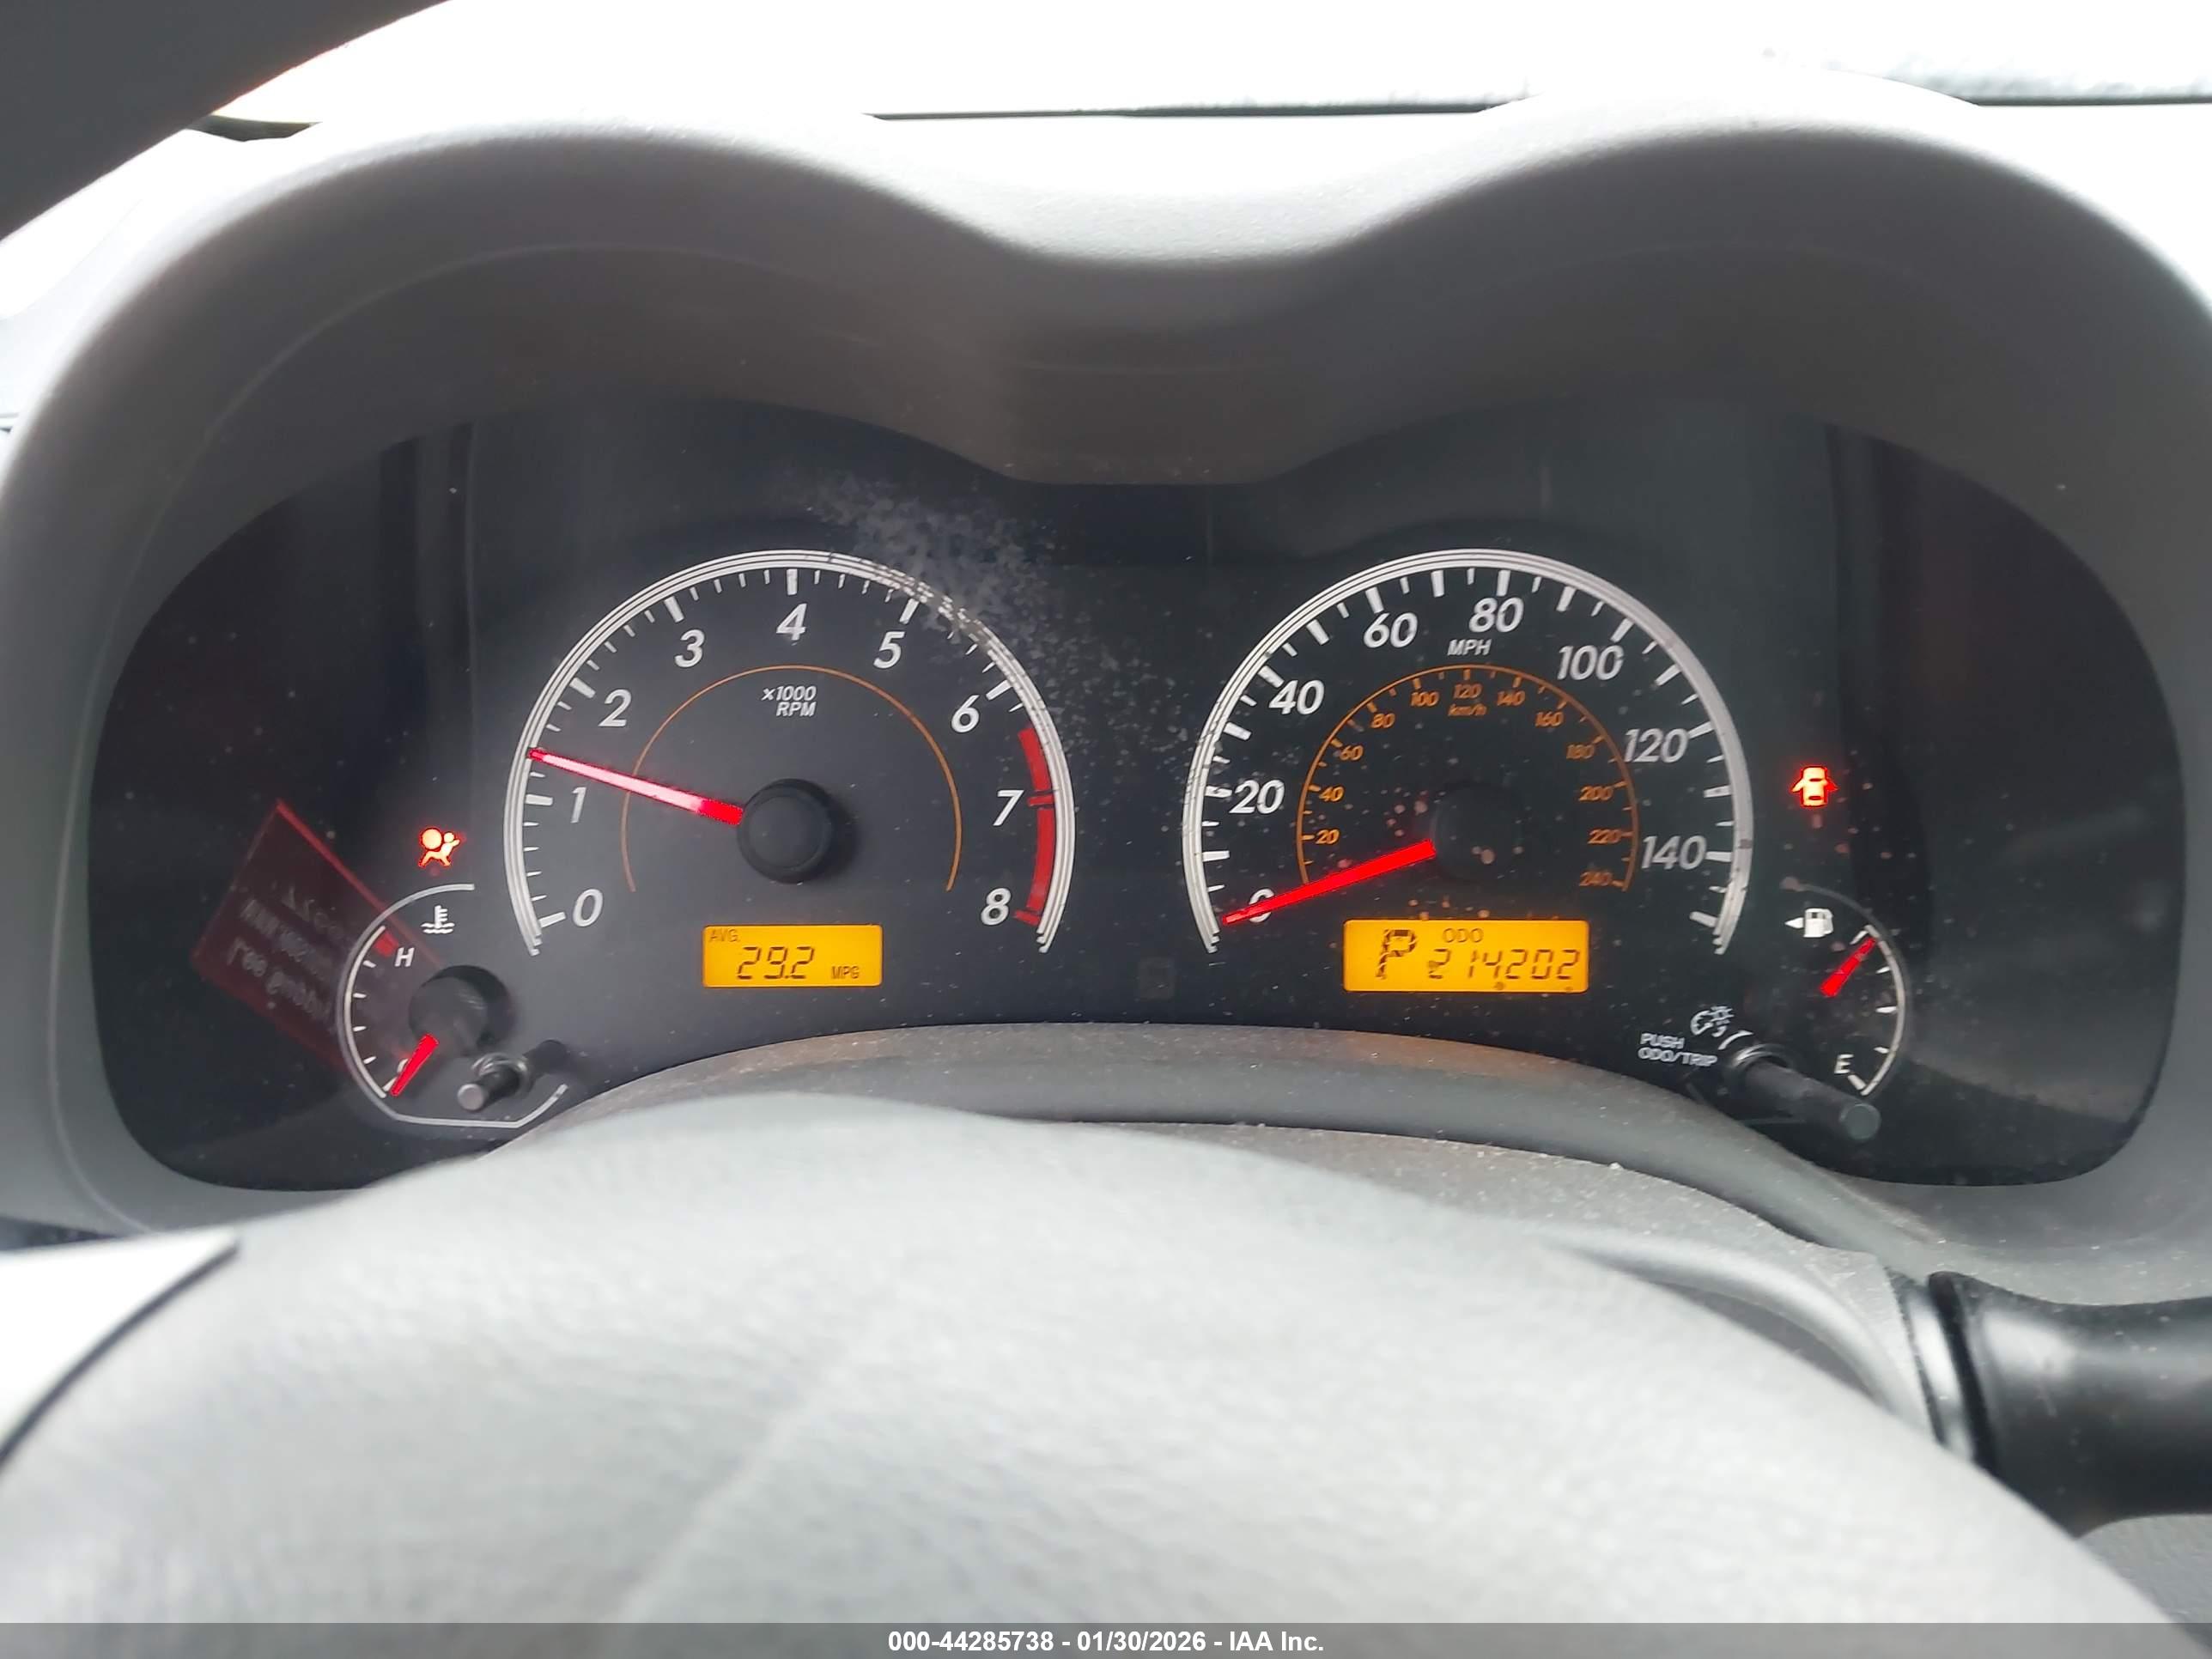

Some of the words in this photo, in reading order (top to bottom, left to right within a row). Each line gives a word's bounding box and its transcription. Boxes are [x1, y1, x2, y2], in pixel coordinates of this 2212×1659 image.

[776, 604, 807, 641] 4
[1469, 598, 1524, 633] 80
[1364, 611, 1419, 648] 60
[675, 629, 705, 668] 3
[874, 632, 905, 669] 5
[1447, 639, 1492, 656] MPH
[1558, 644, 1624, 681] 100
[761, 685, 817, 702] x1000
[1269, 679, 1325, 715] 40
[1410, 691, 1440, 708] 100
[1454, 683, 1484, 699] 120
[1497, 690, 1526, 707] 140
[599, 690, 632, 727] 2
[775, 701, 817, 717] RPM
[951, 696, 980, 733] 6
[1447, 702, 1488, 718] km/h
[1534, 710, 1565, 727] 160
[1371, 712, 1395, 729] 80
[1340, 744, 1364, 762] 60
[1565, 744, 1595, 761] 180
[1625, 728, 1689, 763] 120
[1229, 779, 1285, 815] 20
[1318, 786, 1346, 803] 40
[1578, 786, 1614, 802] 200
[571, 787, 586, 823] 1
[994, 790, 1024, 826] 7
[1316, 829, 1340, 845] 20
[1587, 829, 1621, 845] 220
[1641, 836, 1706, 870] 140
[1579, 871, 1611, 888] 240
[573, 889, 604, 927] 0
[981, 888, 1012, 926] 8
[1443, 928, 1484, 943] ODO
[394, 947, 415, 968] H
[737, 946, 815, 980] 29.2
[830, 965, 860, 979] MPG
[1375, 929, 1417, 980] P
[1428, 948, 1581, 980] 214202
[1640, 1033, 1685, 1049] PUSH
[1638, 1047, 1718, 1066] ODO/TRIP
[1834, 1054, 1855, 1074] E
